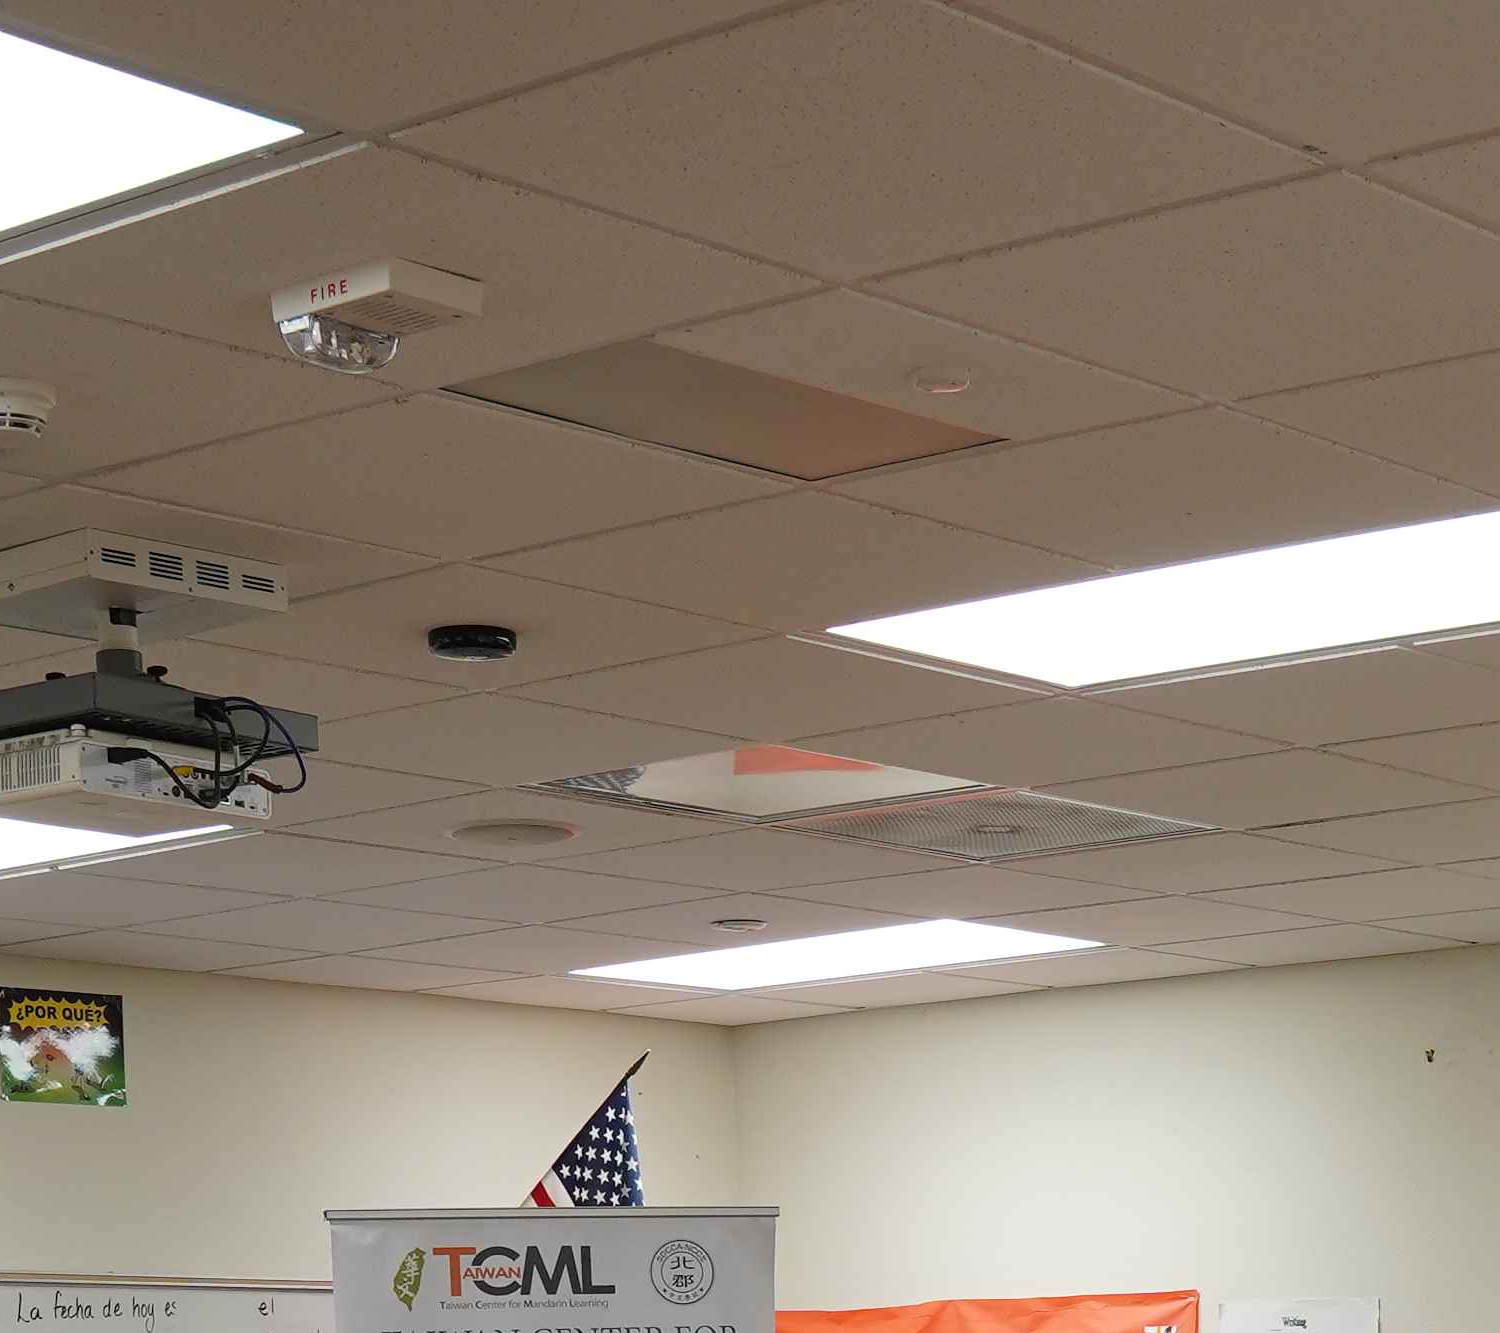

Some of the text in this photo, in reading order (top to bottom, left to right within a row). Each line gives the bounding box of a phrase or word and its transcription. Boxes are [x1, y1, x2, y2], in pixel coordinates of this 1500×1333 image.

[310, 279, 349, 303] FIRE
[16, 1004, 103, 1024] ¿POR QUÉ?
[17, 1292, 43, 1323] La
[53, 1291, 93, 1320] fecha
[103, 1296, 123, 1317] de
[132, 1296, 155, 1333] hoy
[258, 1297, 274, 1316] el
[440, 1301, 473, 1310] Taiwan
[475, 1301, 506, 1309] Center
[523, 1300, 568, 1309] Mandarin
[569, 1299, 609, 1310] Learning
